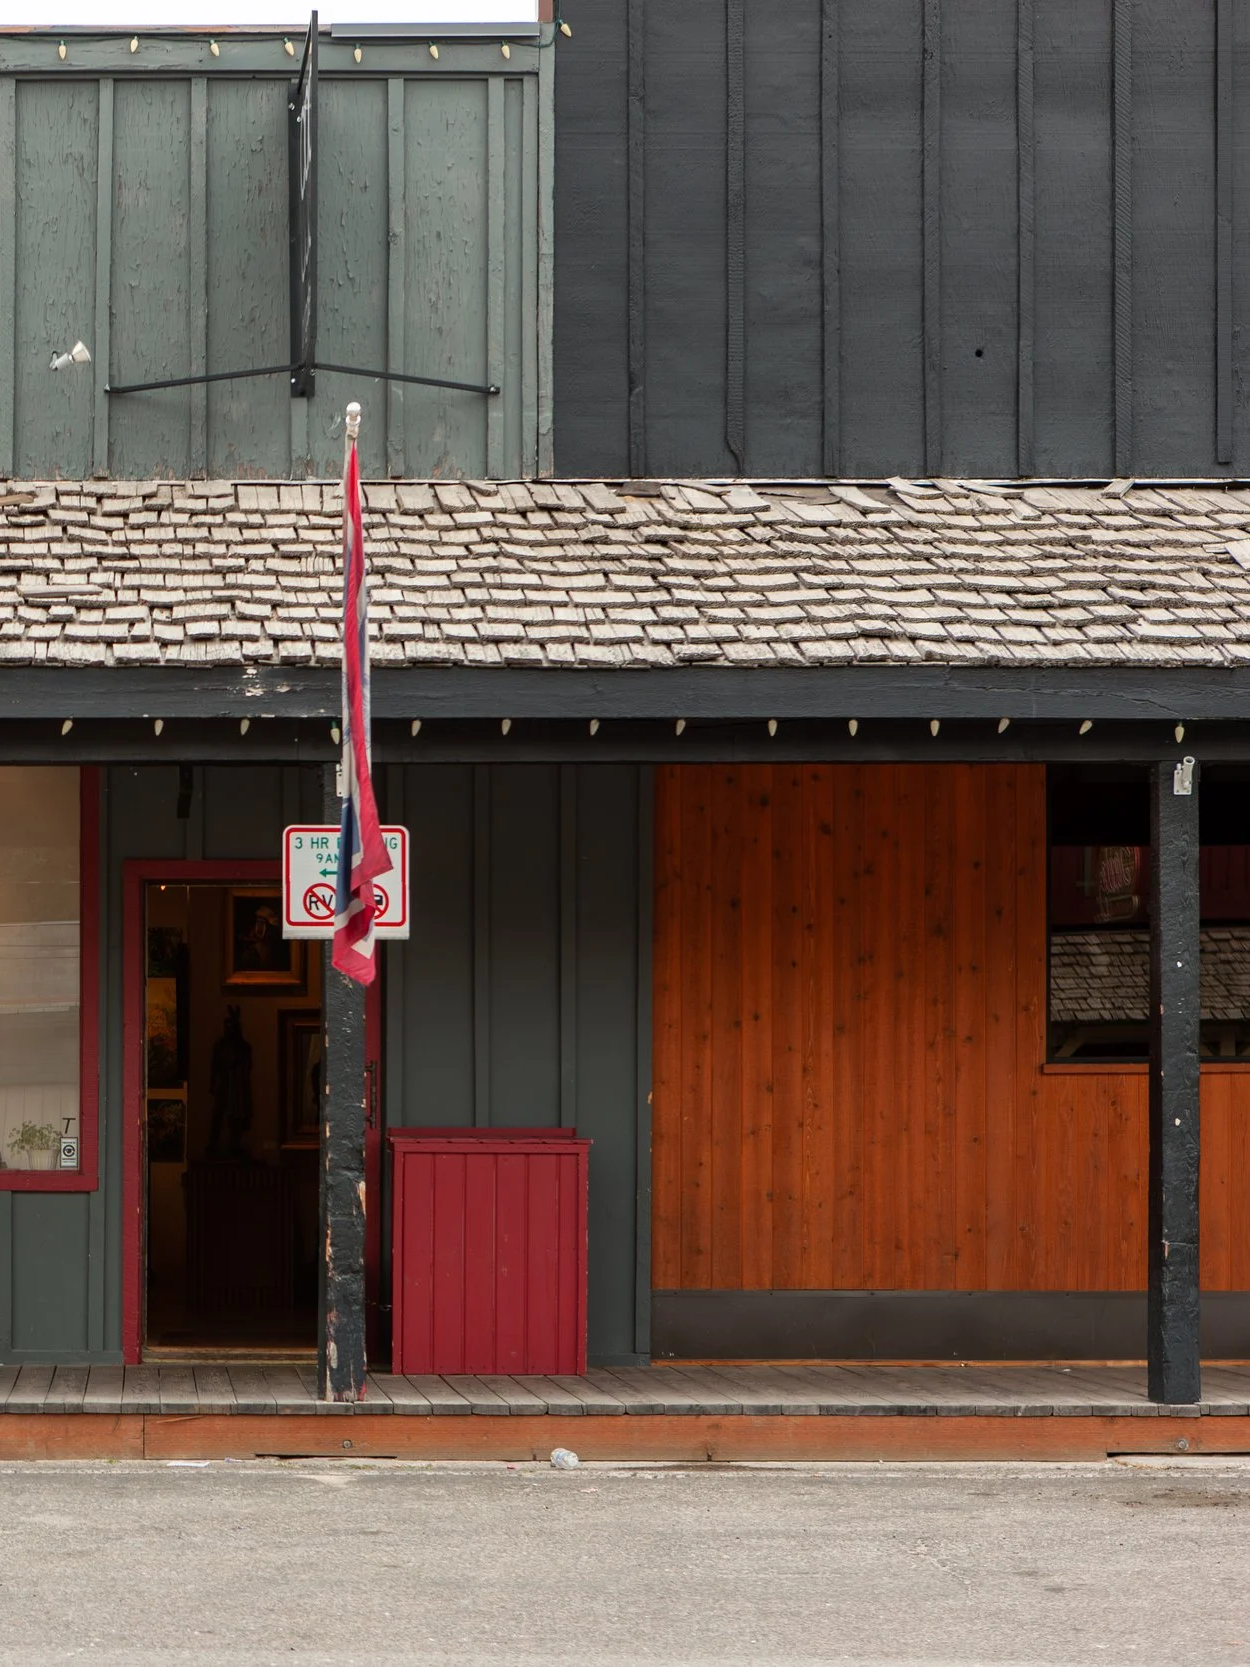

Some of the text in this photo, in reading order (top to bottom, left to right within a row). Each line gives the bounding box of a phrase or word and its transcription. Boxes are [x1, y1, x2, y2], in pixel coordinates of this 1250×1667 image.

[295, 837, 303, 849] 3
[310, 837, 329, 849] HR
[308, 894, 333, 911] RV
